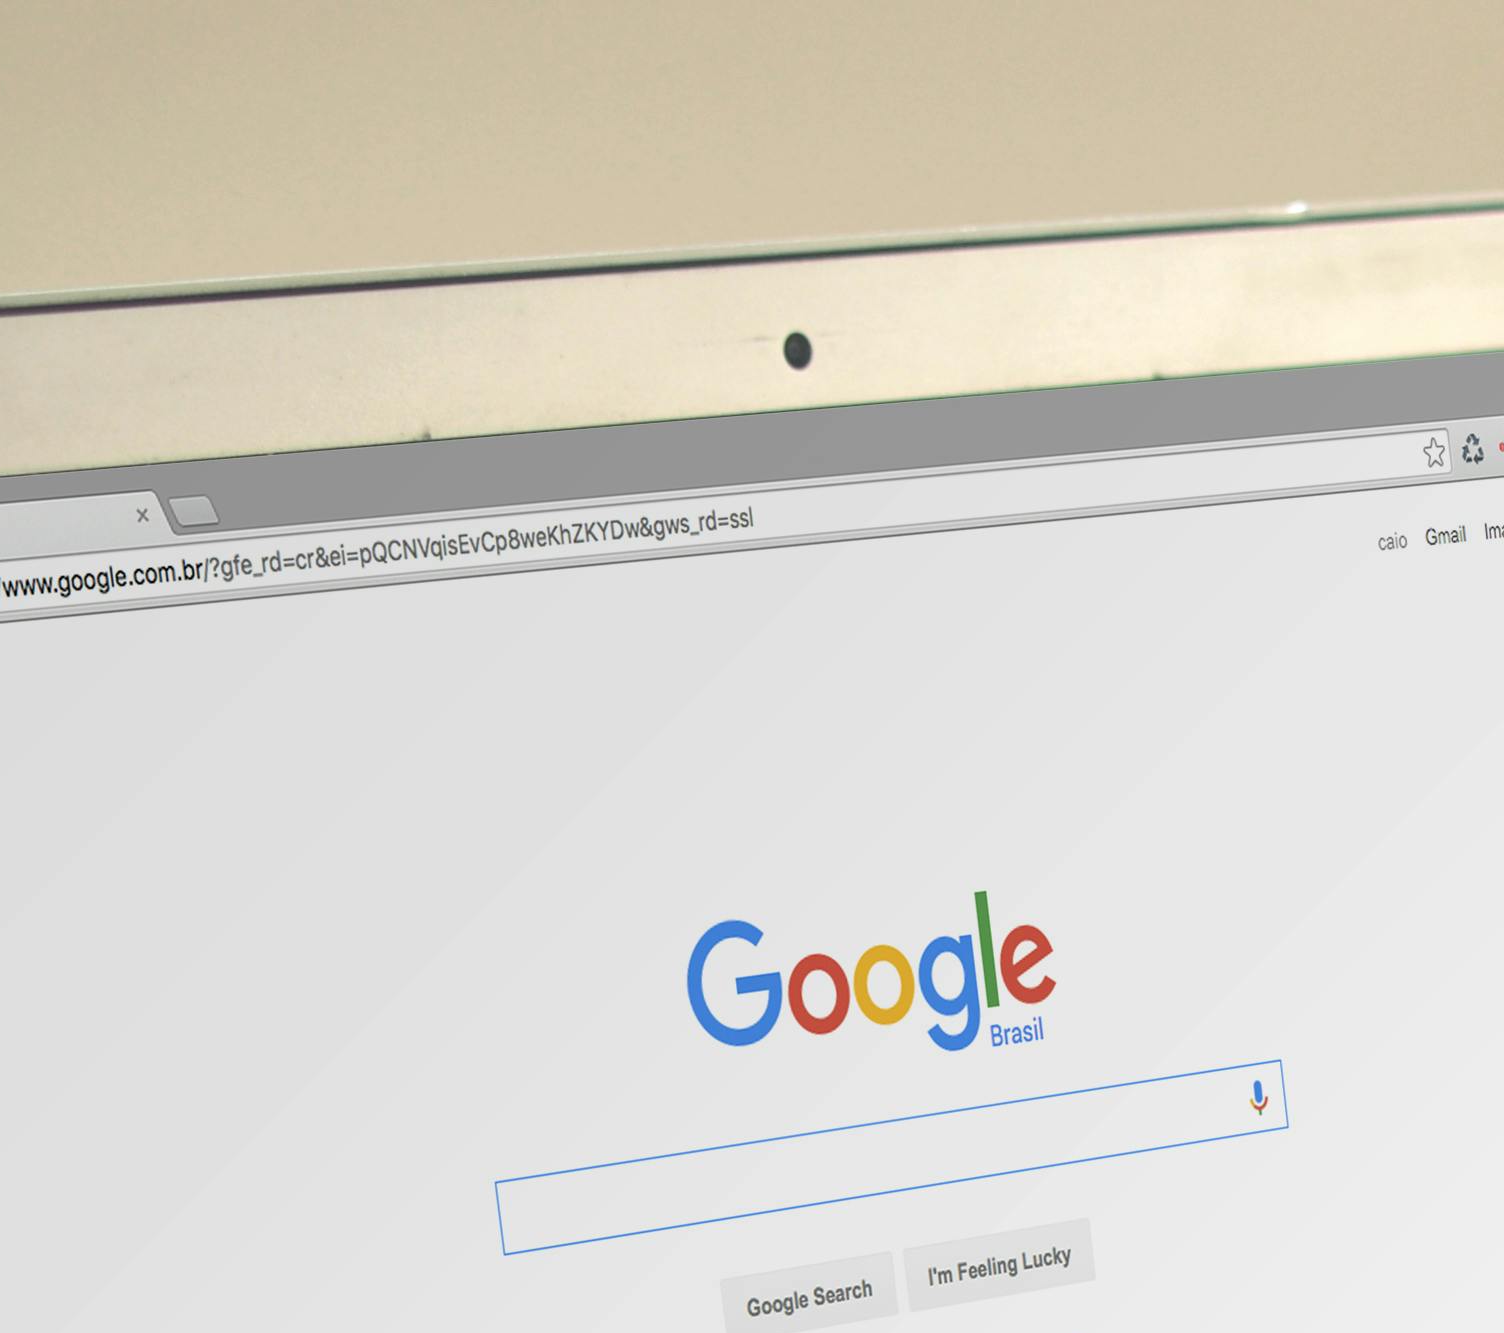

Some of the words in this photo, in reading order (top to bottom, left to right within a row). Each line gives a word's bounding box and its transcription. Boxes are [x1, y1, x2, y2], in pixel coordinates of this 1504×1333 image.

[1378, 532, 1407, 550] caio
[1426, 526, 1466, 545] Gmail
[687, 891, 1056, 1051] Google
[991, 1017, 1043, 1047] Brasil
[928, 1268, 953, 1286] I'm
[958, 1258, 1017, 1281] Feeling
[1022, 1247, 1071, 1269] Lucky
[747, 1292, 808, 1316] Google
[814, 1280, 872, 1305] Search
